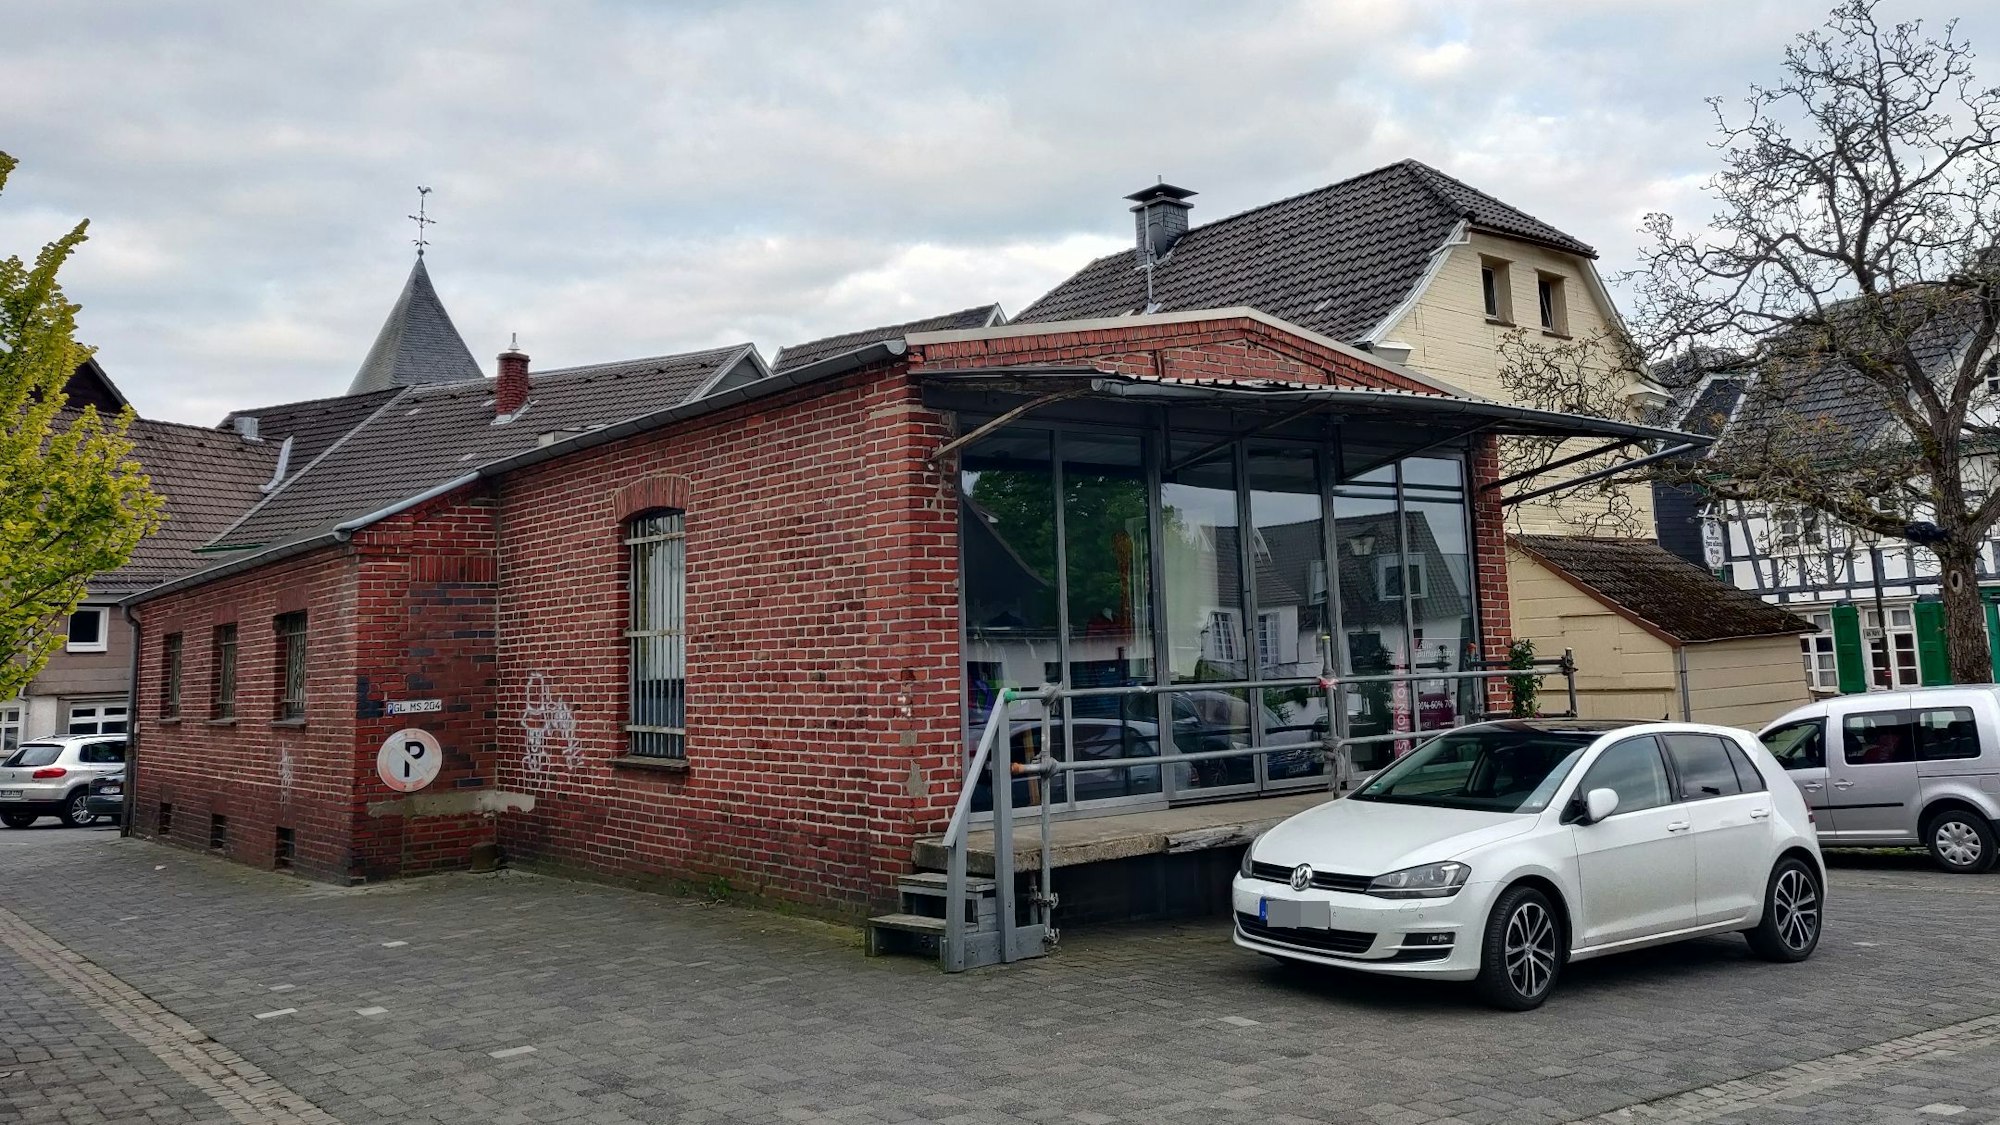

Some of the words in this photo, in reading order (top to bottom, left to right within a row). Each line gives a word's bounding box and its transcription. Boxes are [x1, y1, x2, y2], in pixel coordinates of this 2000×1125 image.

[394, 703, 405, 712] GL
[410, 703, 422, 712] MS
[424, 701, 440, 710] 204
[404, 741, 425, 778] P
